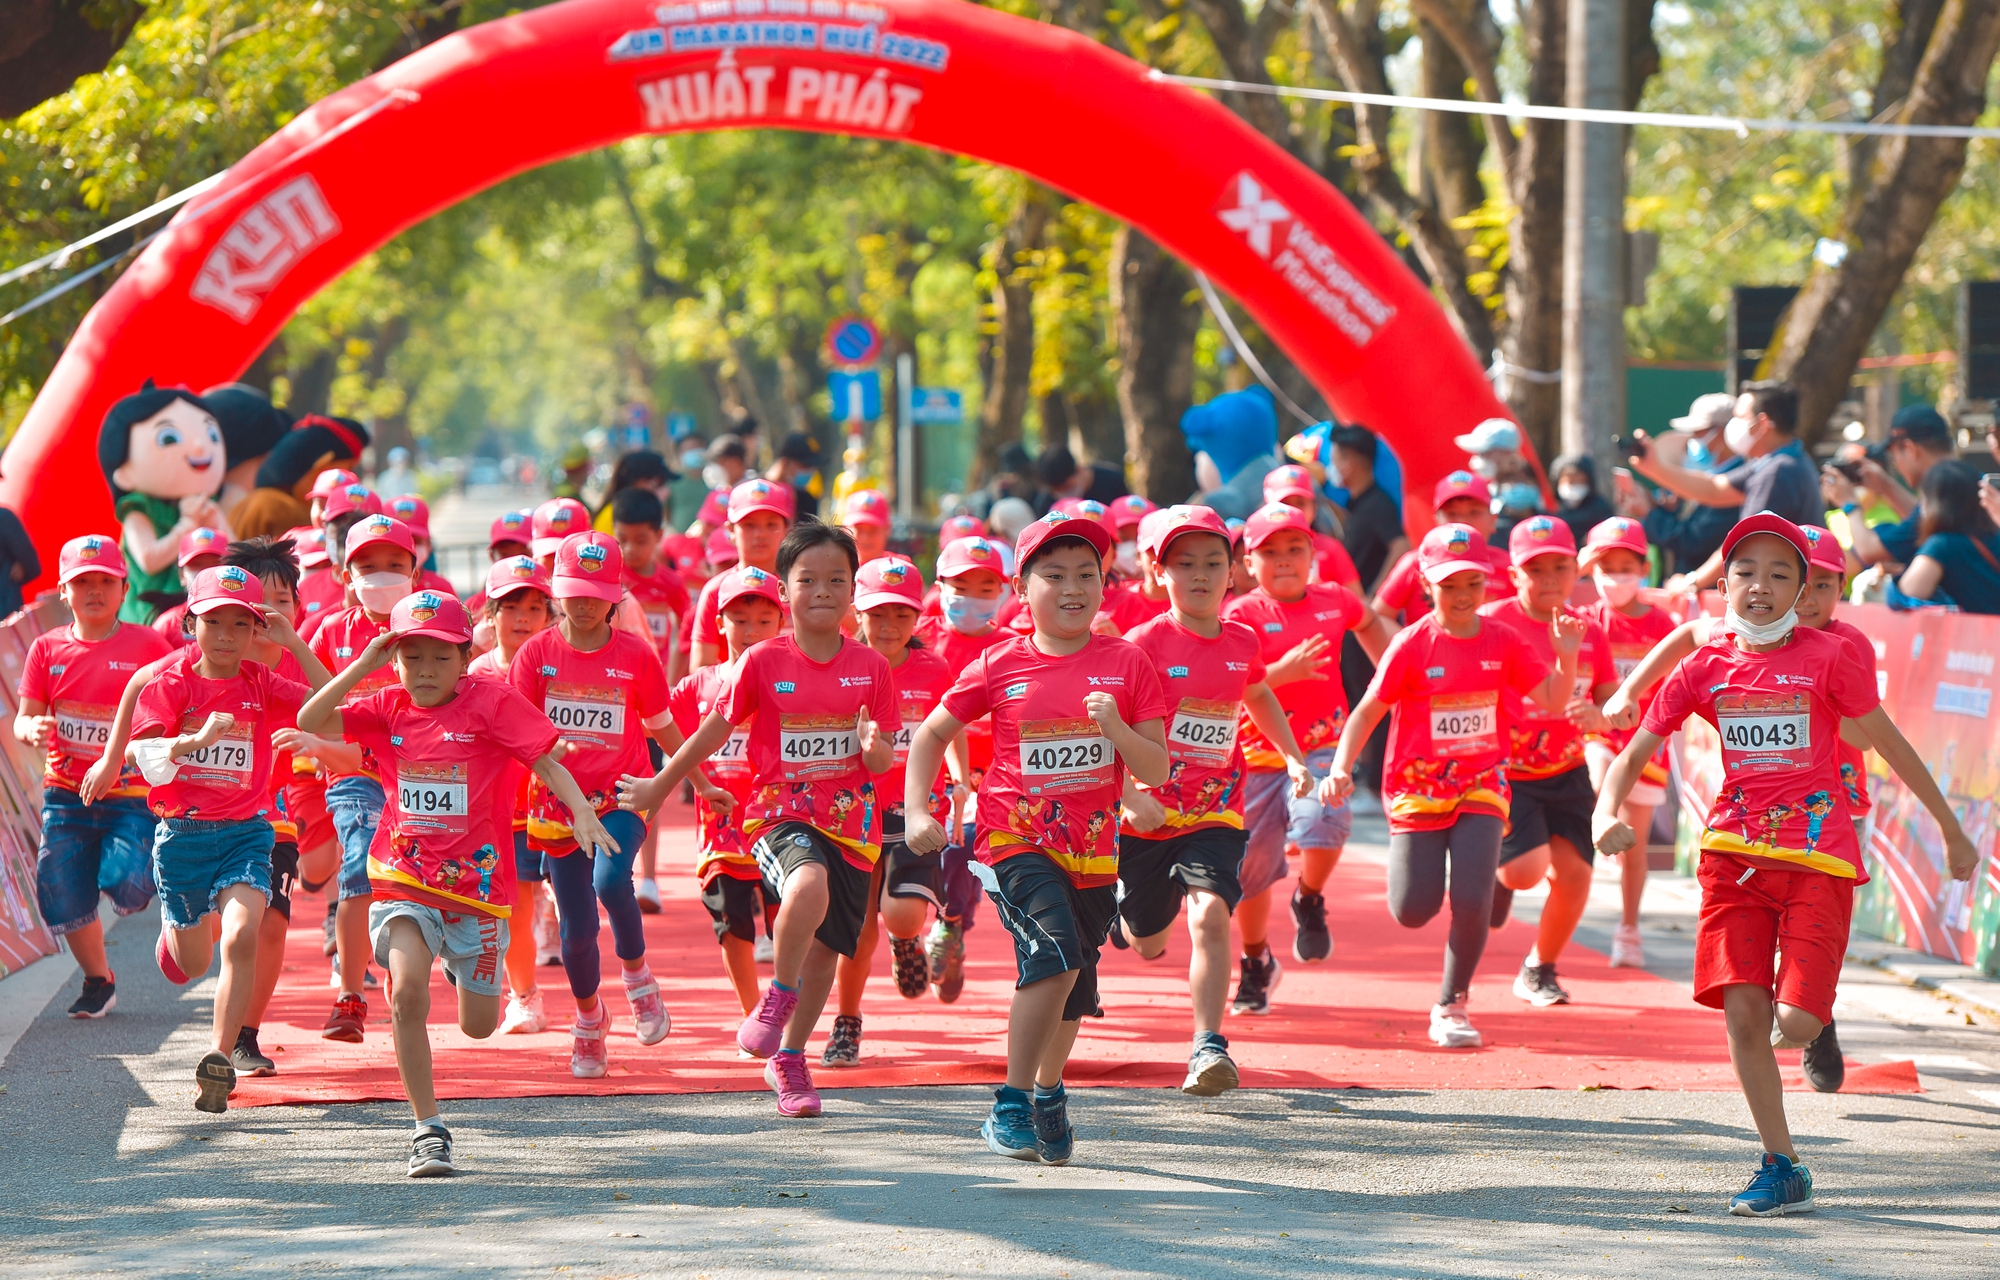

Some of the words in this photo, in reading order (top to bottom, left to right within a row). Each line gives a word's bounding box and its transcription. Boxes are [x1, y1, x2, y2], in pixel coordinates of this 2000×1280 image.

[669, 21, 820, 52] MARATHON
[879, 32, 949, 73] 2022
[638, 47, 775, 129] XUẤT
[785, 67, 923, 131] PHÁT
[548, 705, 612, 729] 40078
[1437, 714, 1488, 734] 40291
[58, 721, 108, 743] 40178
[1176, 721, 1234, 745] 40254
[1726, 723, 1797, 747] 40043
[785, 736, 850, 758] 40211
[1027, 743, 1103, 770] 40229
[399, 786, 452, 811] 0194
